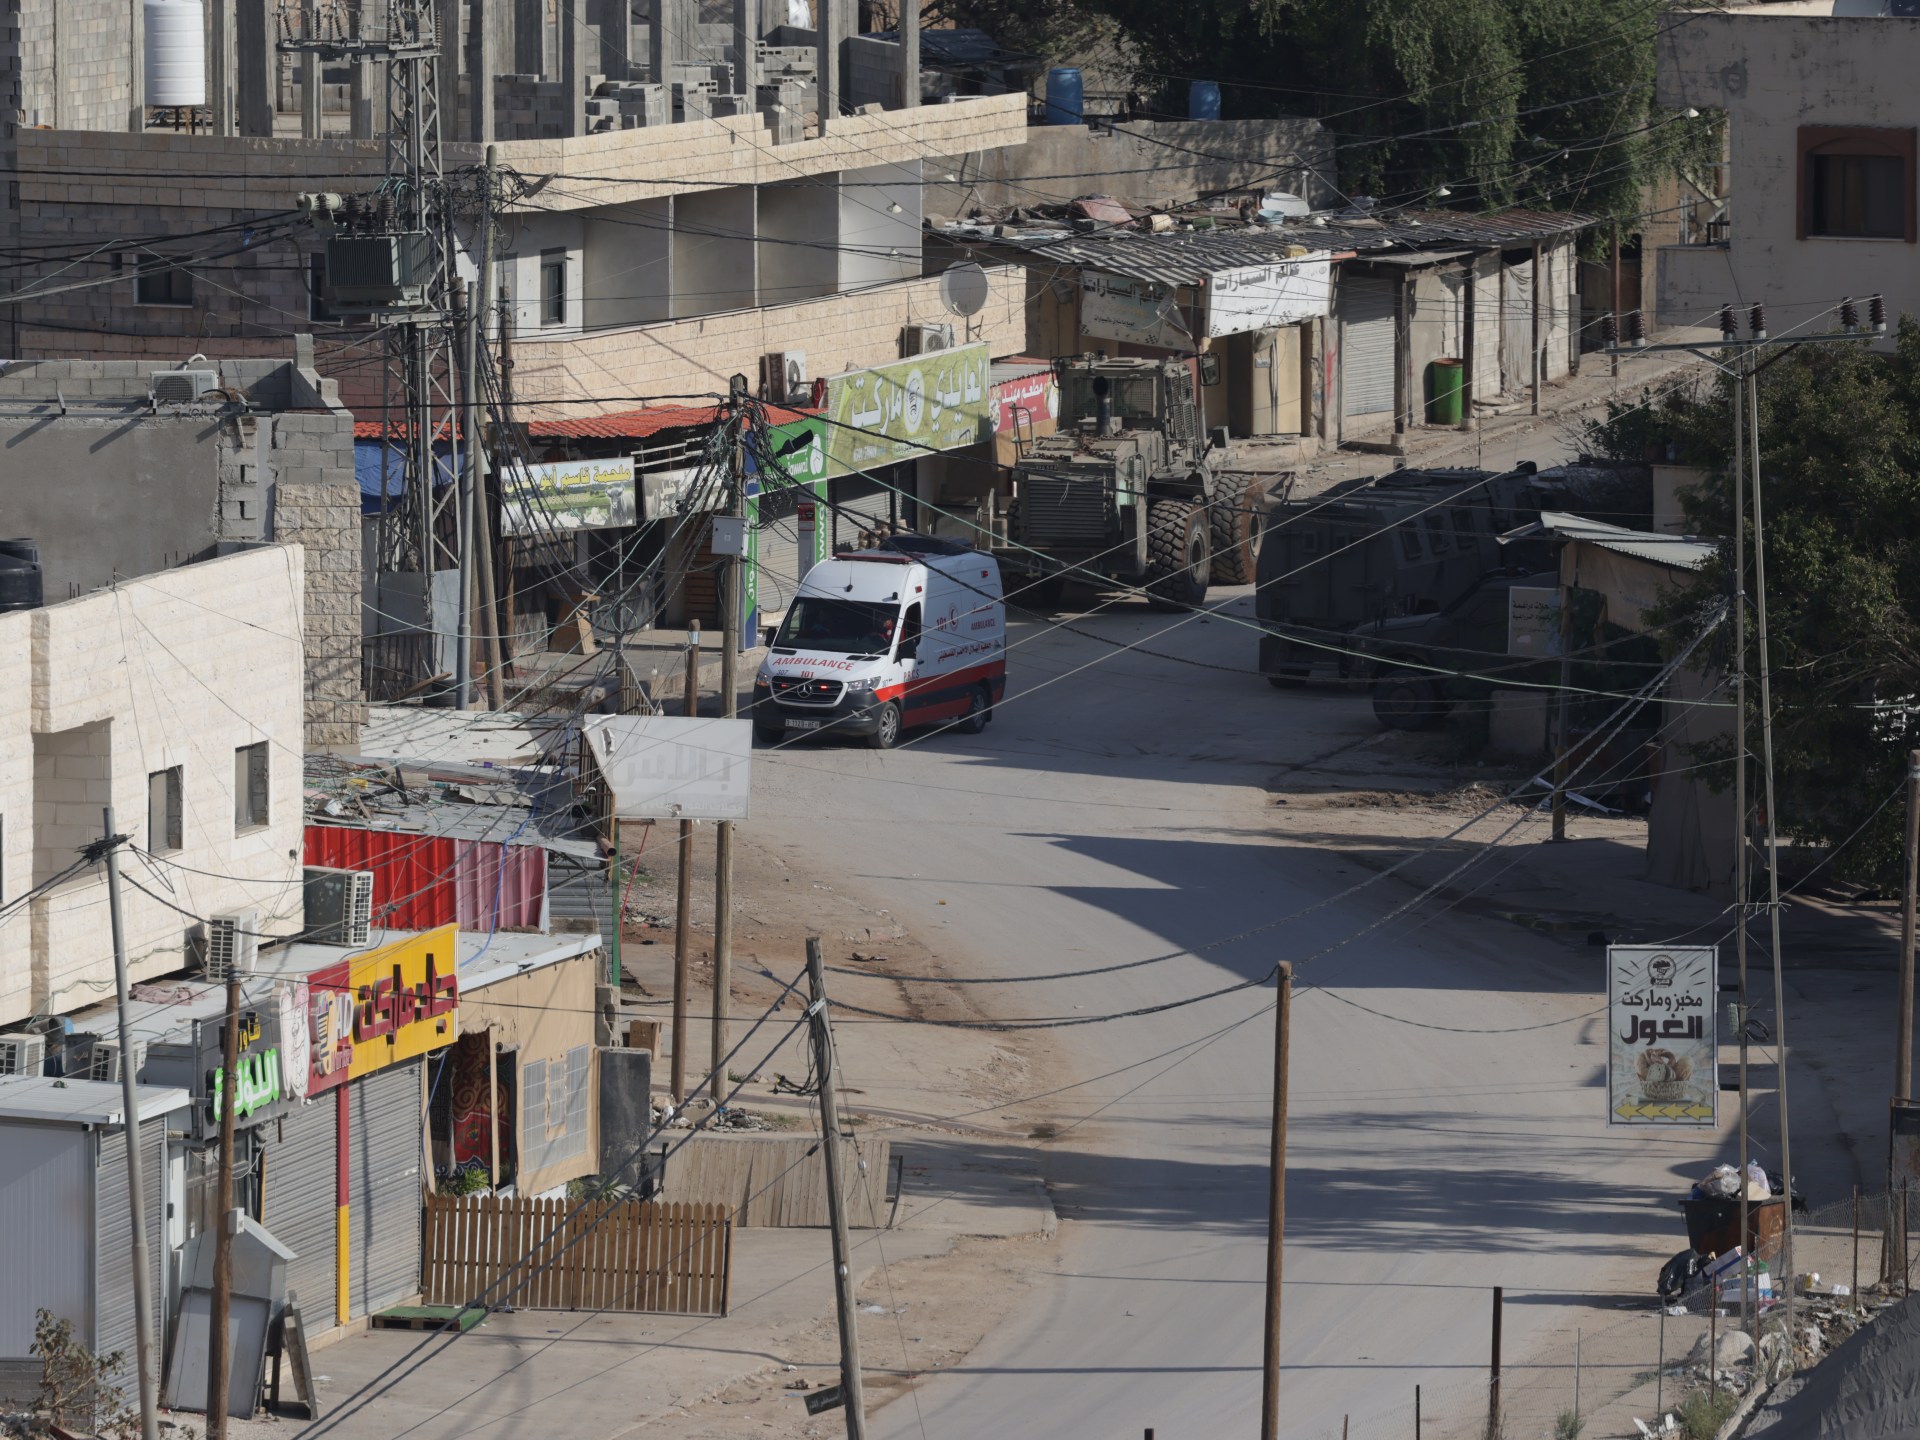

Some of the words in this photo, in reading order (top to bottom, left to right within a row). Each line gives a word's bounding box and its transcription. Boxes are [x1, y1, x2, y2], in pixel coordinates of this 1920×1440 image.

[1083, 277, 1136, 300] السيارات
[1214, 266, 1272, 292] السيارات
[930, 354, 988, 433] العايدي
[1001, 384, 1021, 405] مهند
[1020, 377, 1043, 406] مطعم
[851, 374, 902, 436] ماركت
[539, 465, 558, 492] أبو
[560, 466, 591, 491] قاسم
[593, 463, 632, 483] ملحمة
[936, 617, 947, 632] 101
[772, 657, 855, 672] AMBULANCE
[800, 670, 815, 678] 101
[354, 963, 416, 1048] ماركت
[415, 952, 459, 1036] جاد
[1673, 988, 1703, 1012] مخبز
[1619, 1013, 1704, 1046] الغول
[213, 1048, 280, 1121] اللؤلة
